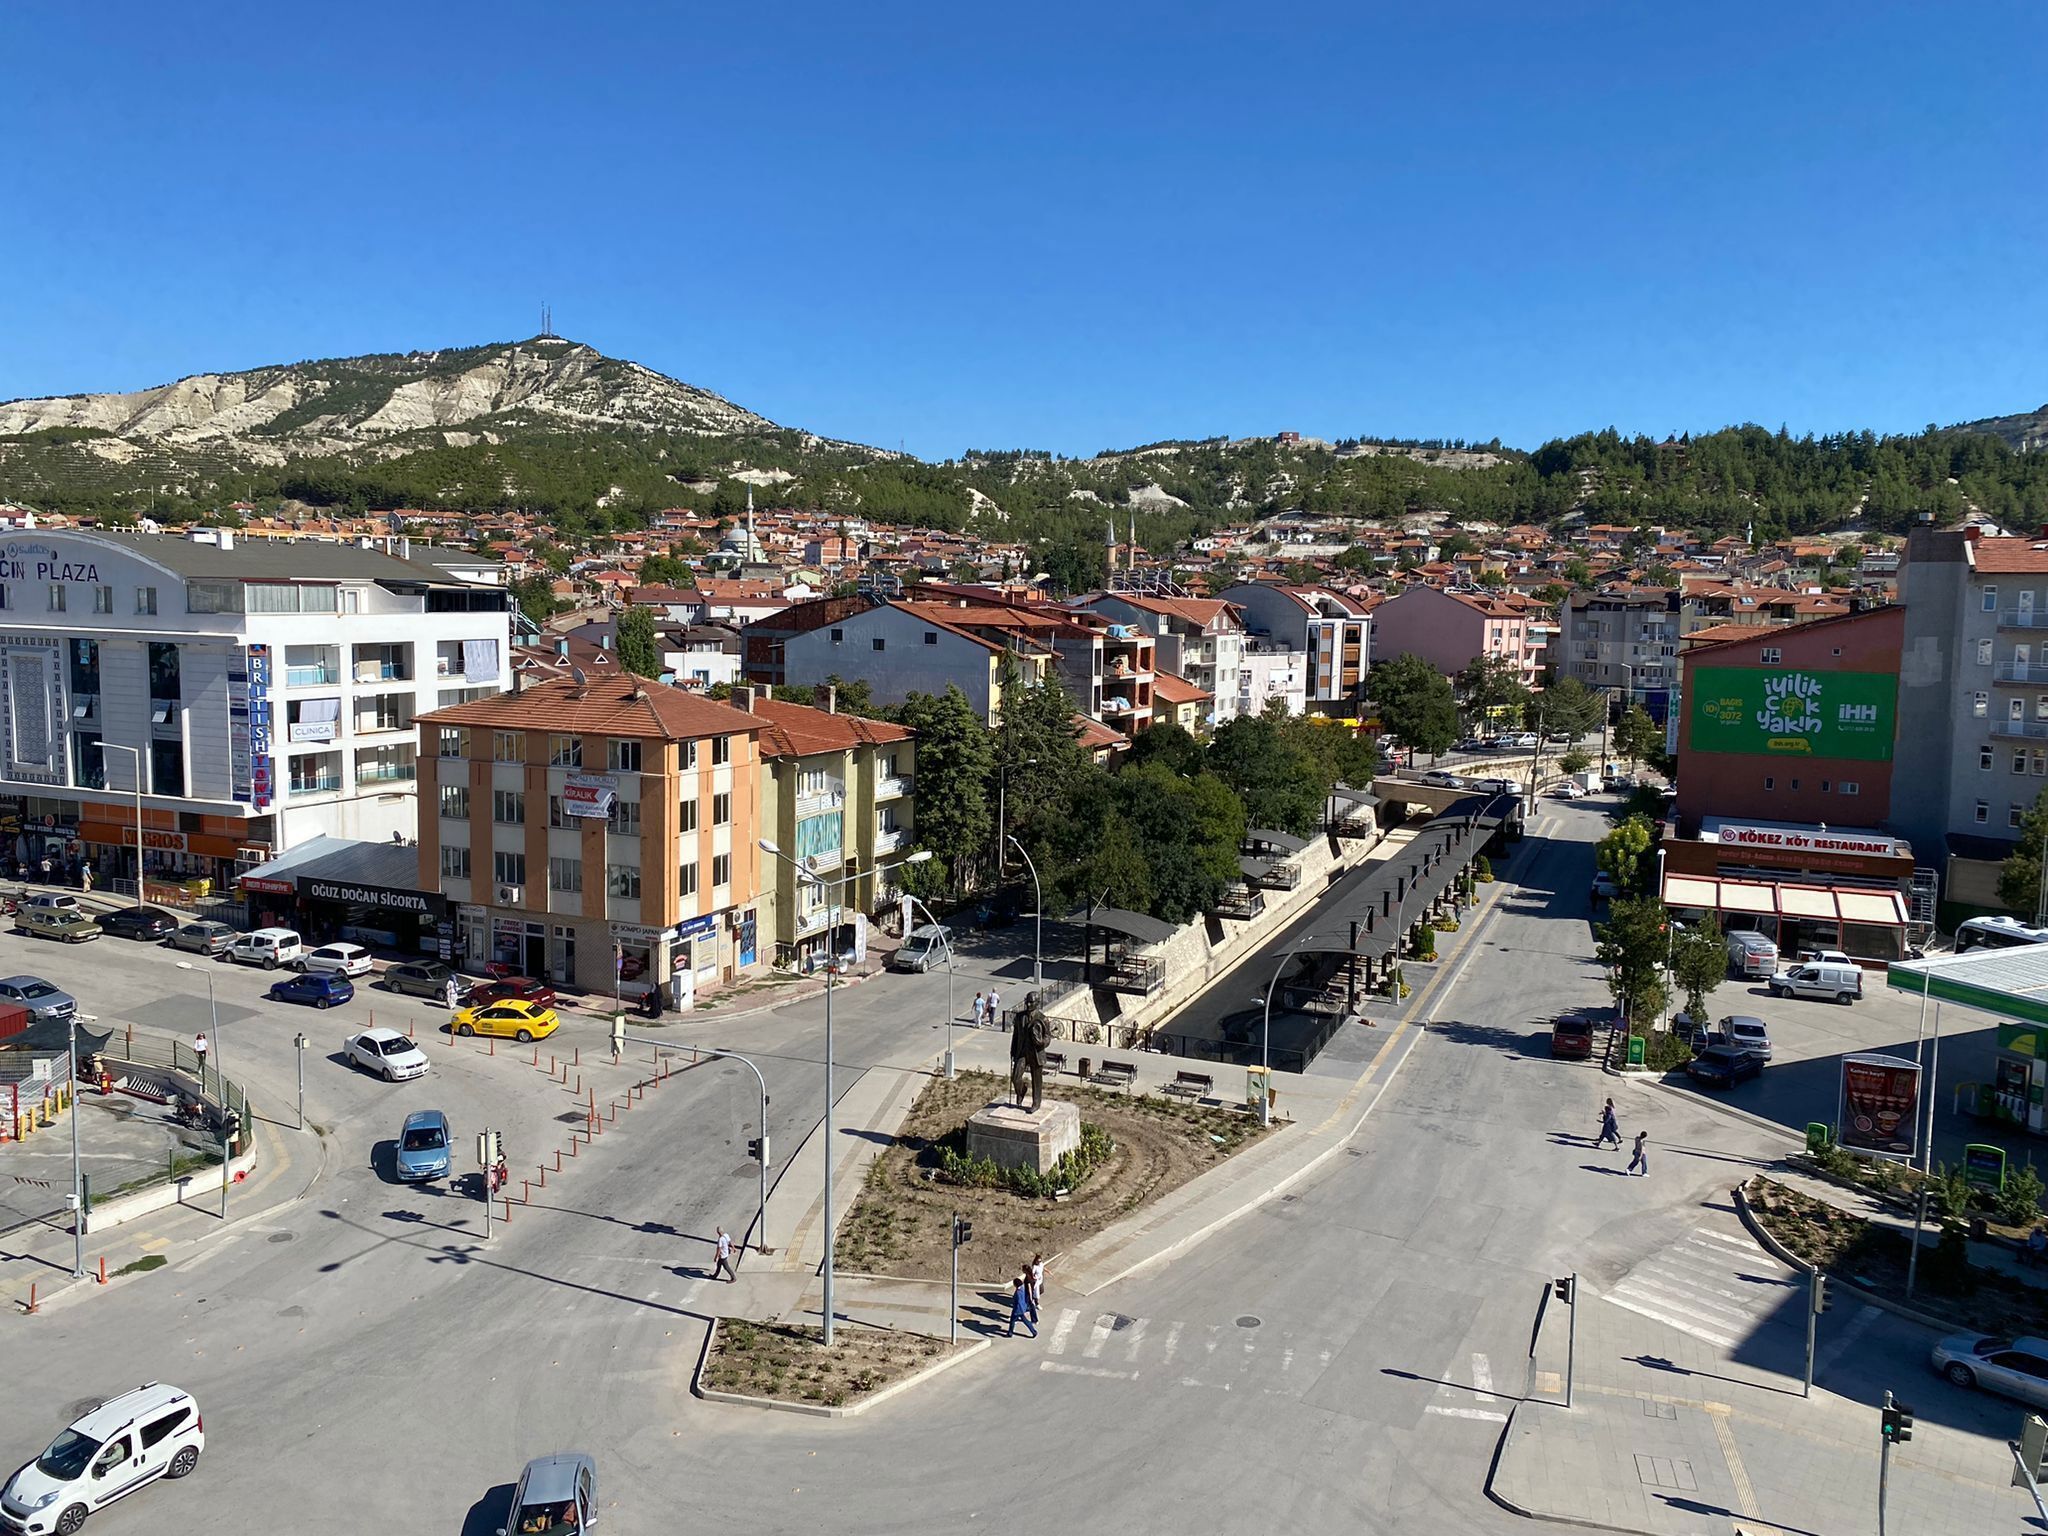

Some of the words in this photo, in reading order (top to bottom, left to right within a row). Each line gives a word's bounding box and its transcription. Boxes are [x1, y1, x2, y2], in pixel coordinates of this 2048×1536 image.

[37, 562, 99, 582] PLAZA
[252, 658, 264, 752] BRITISH
[1720, 711, 1742, 720] 3072
[295, 727, 330, 735] CLINICA
[1738, 829, 1782, 845] KÖKEZ
[1786, 835, 1810, 848] KÖY
[1814, 839, 1889, 853] RESTAURANT
[311, 883, 340, 899] OĞUZ
[341, 888, 378, 904] DOĞAN
[380, 892, 427, 910] SİGORTA
[620, 925, 641, 934] SOMPO
[642, 927, 659, 935] JAPAN
